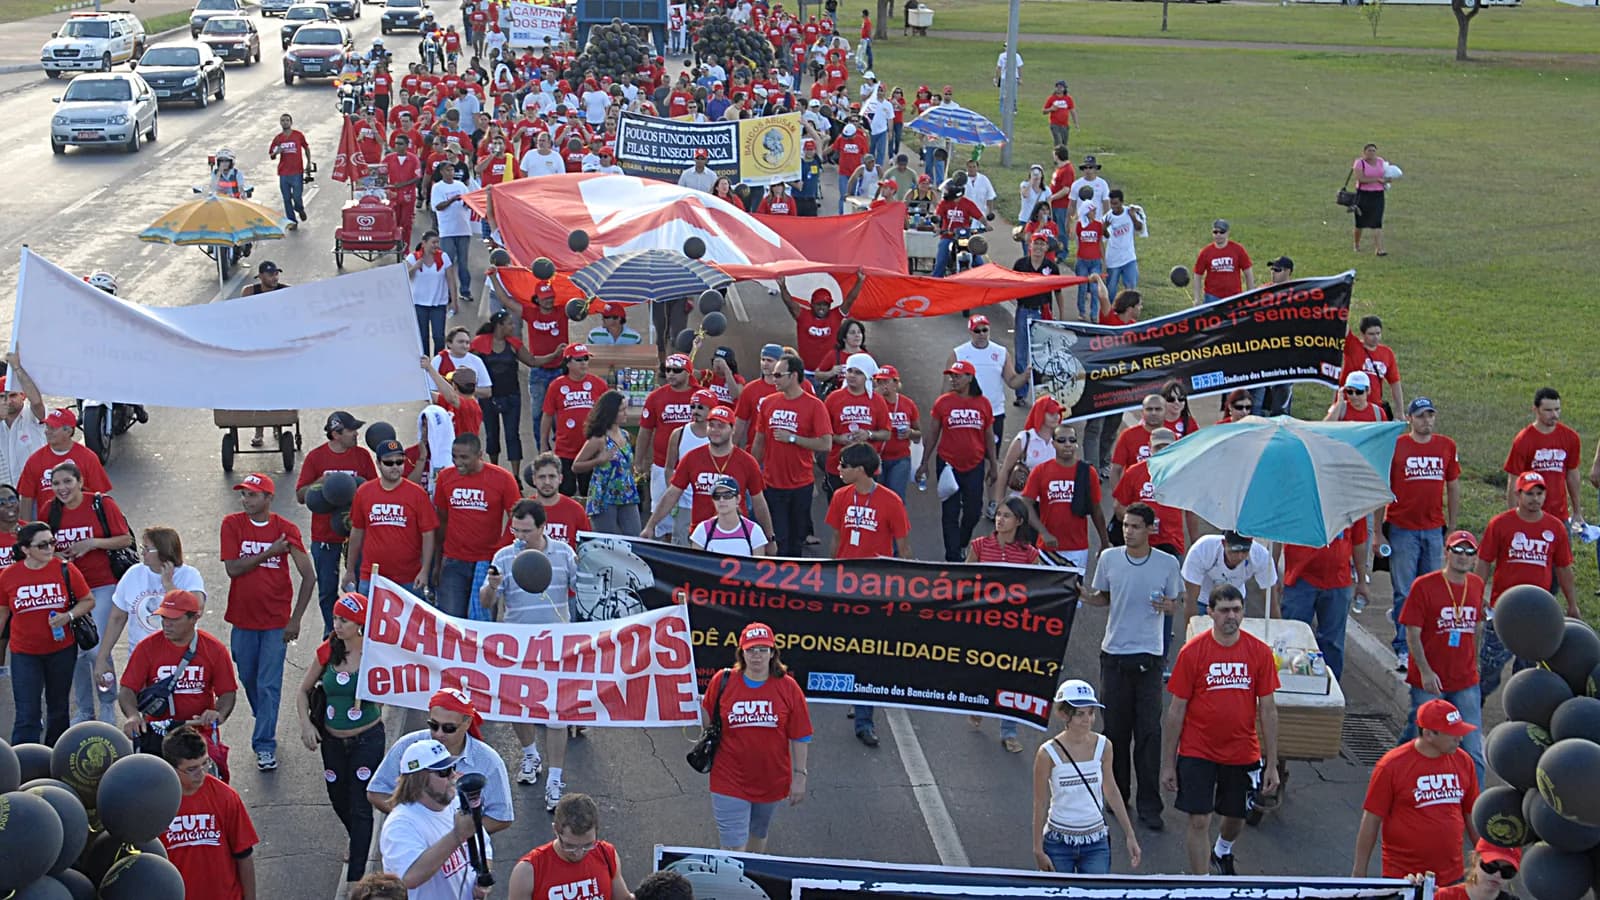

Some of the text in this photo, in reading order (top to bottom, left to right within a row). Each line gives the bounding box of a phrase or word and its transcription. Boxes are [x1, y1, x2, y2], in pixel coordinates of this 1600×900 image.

[626, 142, 650, 154] FILAS
[652, 145, 657, 156] E
[1253, 304, 1348, 323] semestre
[1090, 359, 1128, 381] CADÊ
[1130, 358, 1140, 373] A
[1143, 337, 1291, 371] RESPONSABILIDADE
[719, 558, 1028, 606] 2.224 bancários
[368, 585, 692, 676] BANCÁRIOS
[671, 582, 827, 612] demitidos
[832, 602, 871, 615] no
[918, 606, 1064, 637] semestre
[691, 627, 718, 647] DÊ
[723, 632, 738, 647] A
[966, 650, 1059, 677] SOCIAL?
[367, 663, 430, 696] em
[440, 666, 698, 722] GREVE
[854, 683, 1048, 716] Sindicato dos Bancários de Brasília CUT
